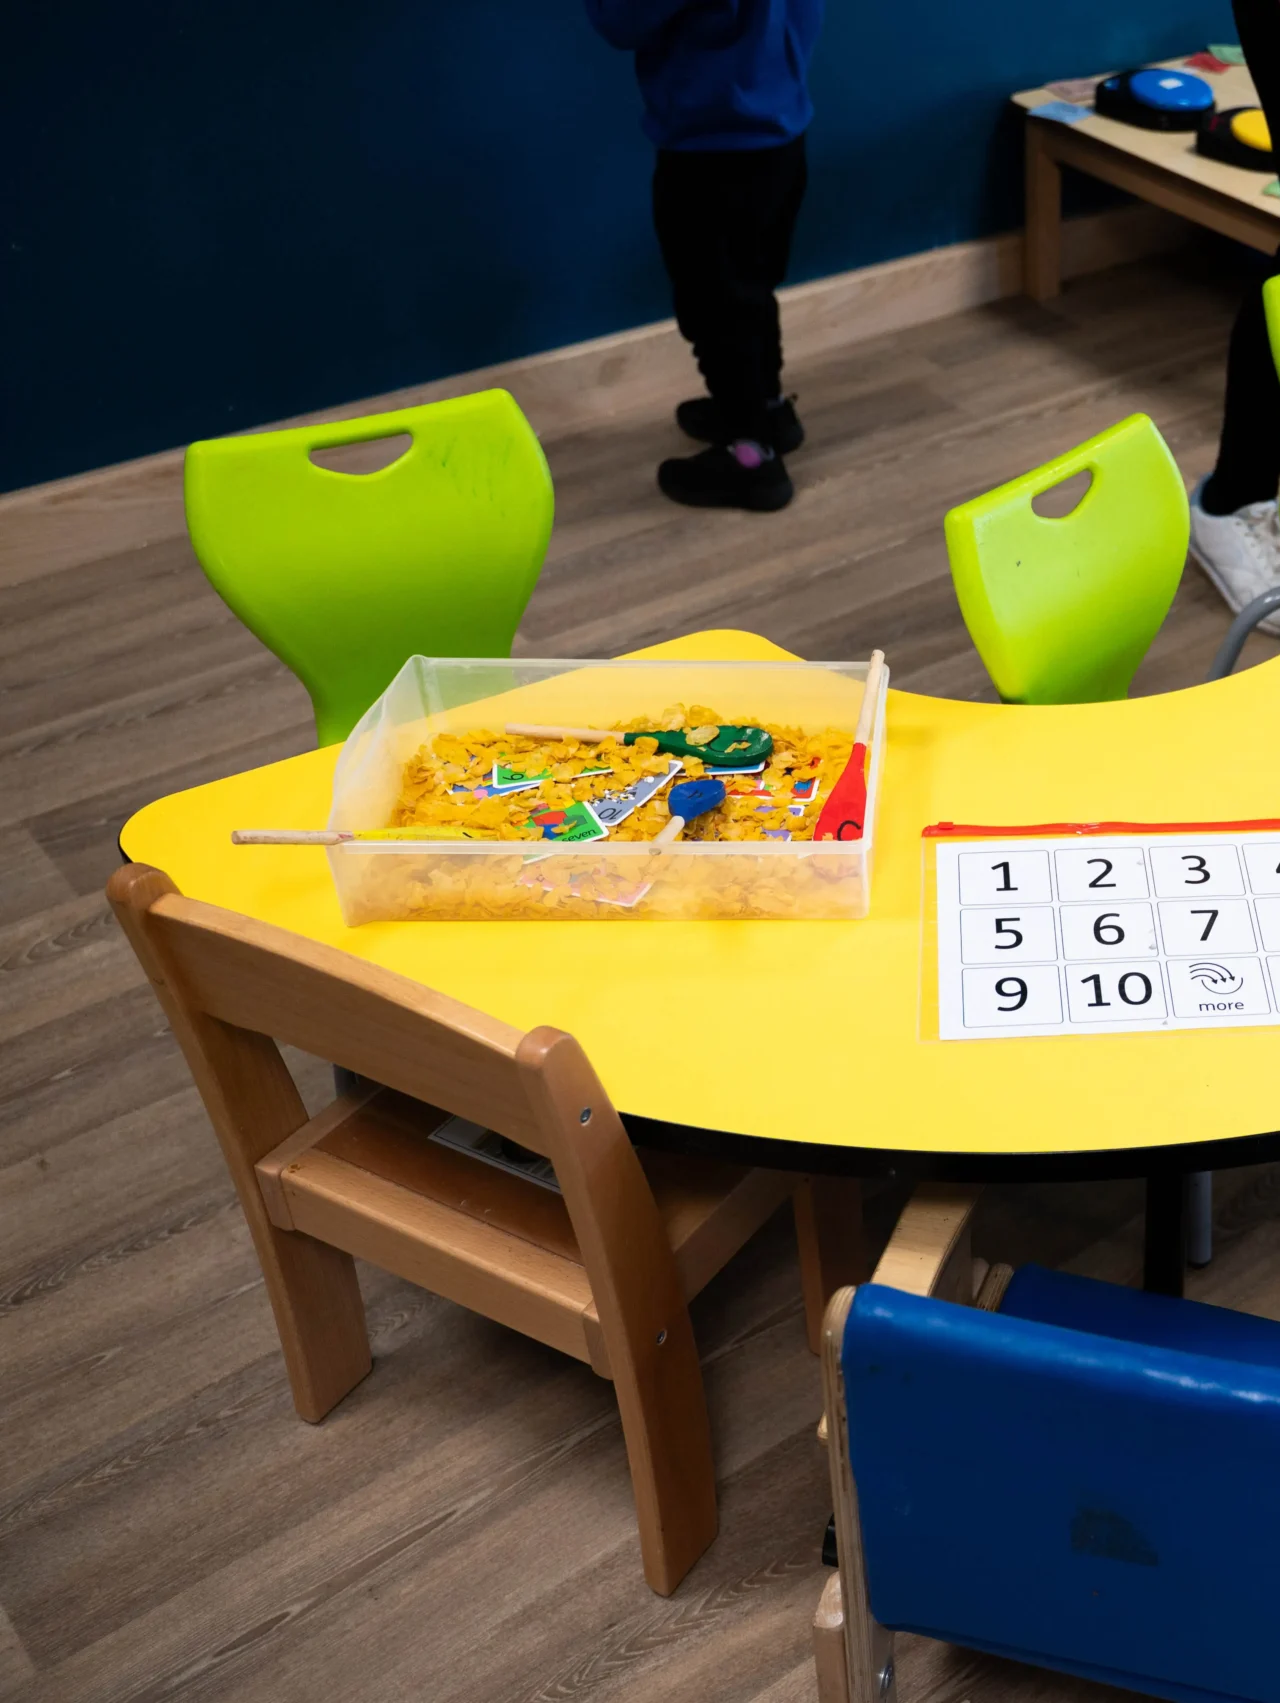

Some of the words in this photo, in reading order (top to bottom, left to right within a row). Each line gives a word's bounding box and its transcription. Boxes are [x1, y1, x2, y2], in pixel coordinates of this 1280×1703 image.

[991, 861, 1019, 892] 1
[1086, 858, 1117, 888] 2
[1181, 855, 1211, 885] 3
[994, 917, 1024, 950] 5
[1093, 913, 1126, 946] 6
[1190, 909, 1219, 942] 7
[994, 976, 1028, 1012] 9
[1080, 971, 1153, 1008] 10
[1198, 999, 1245, 1012] more
